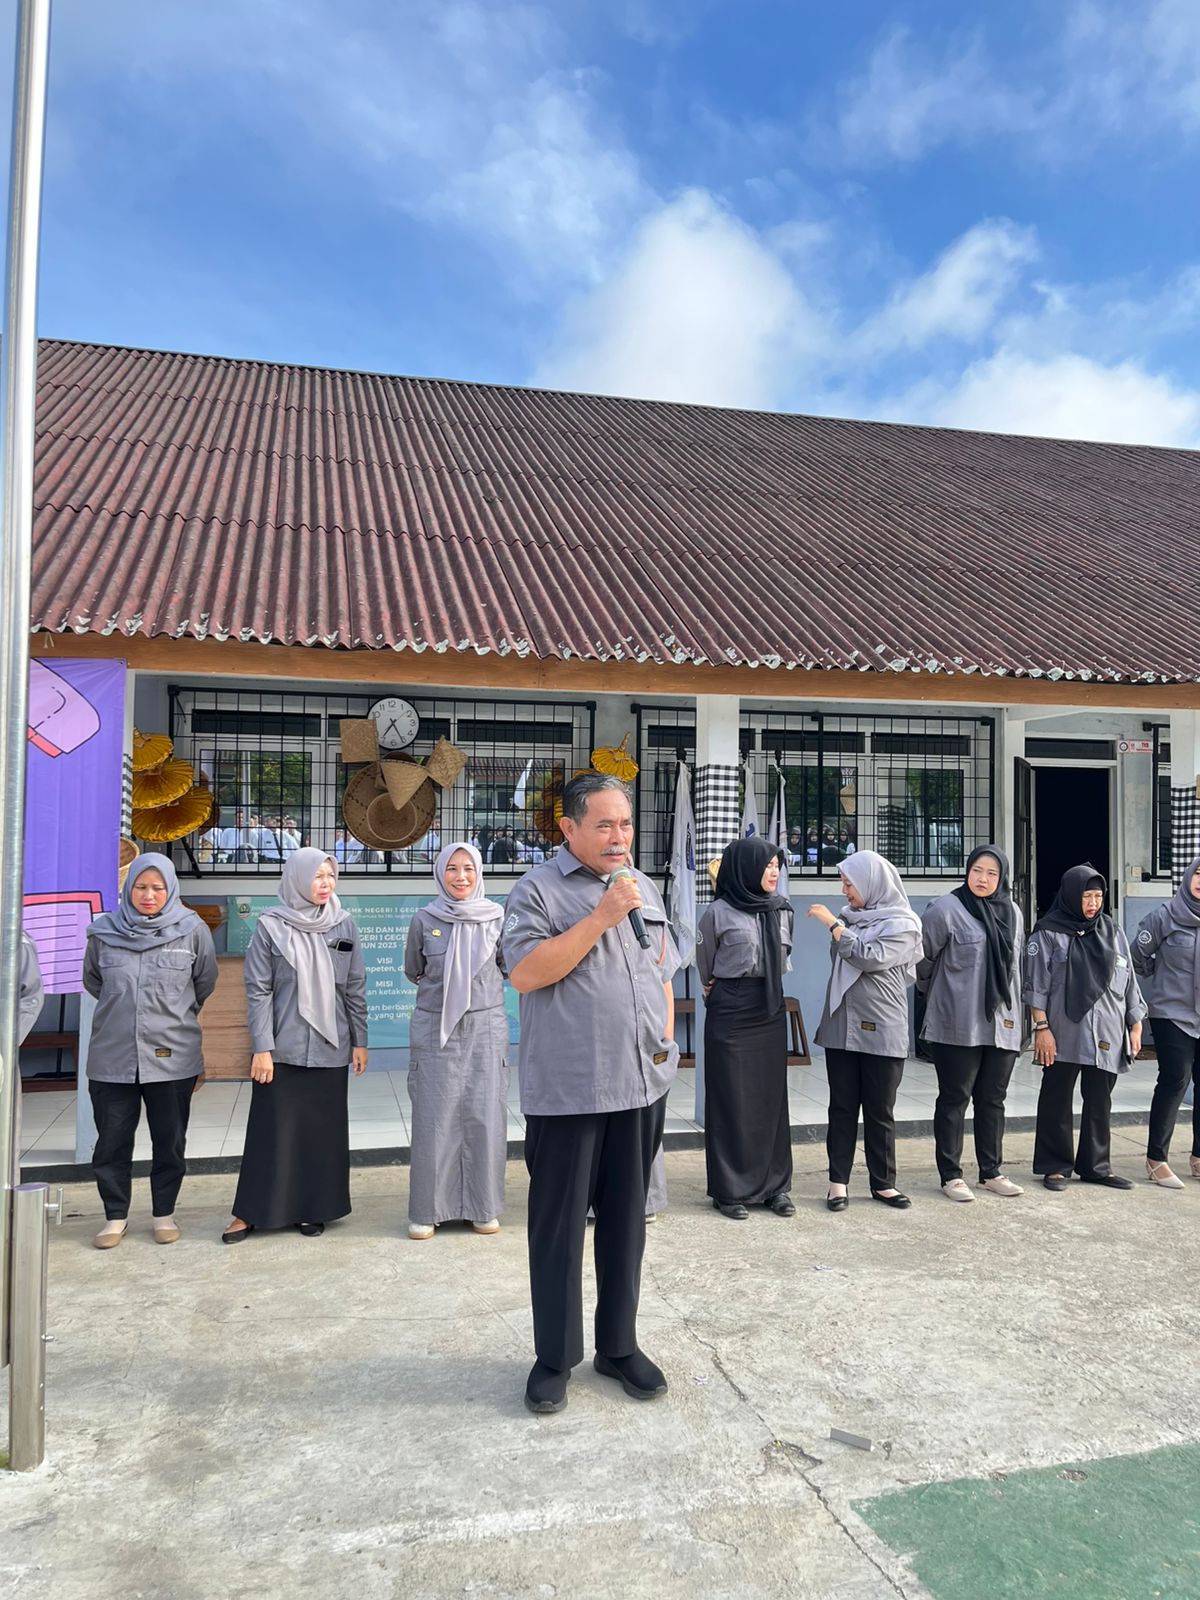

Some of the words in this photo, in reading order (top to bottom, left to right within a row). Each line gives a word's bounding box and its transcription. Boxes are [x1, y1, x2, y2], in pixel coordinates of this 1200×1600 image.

[388, 700, 396, 708] 12
[372, 711, 381, 719] 10
[406, 710, 413, 718] 2
[410, 719, 416, 727] 3
[390, 739, 397, 747] 6
[374, 1012, 394, 1020] yang
